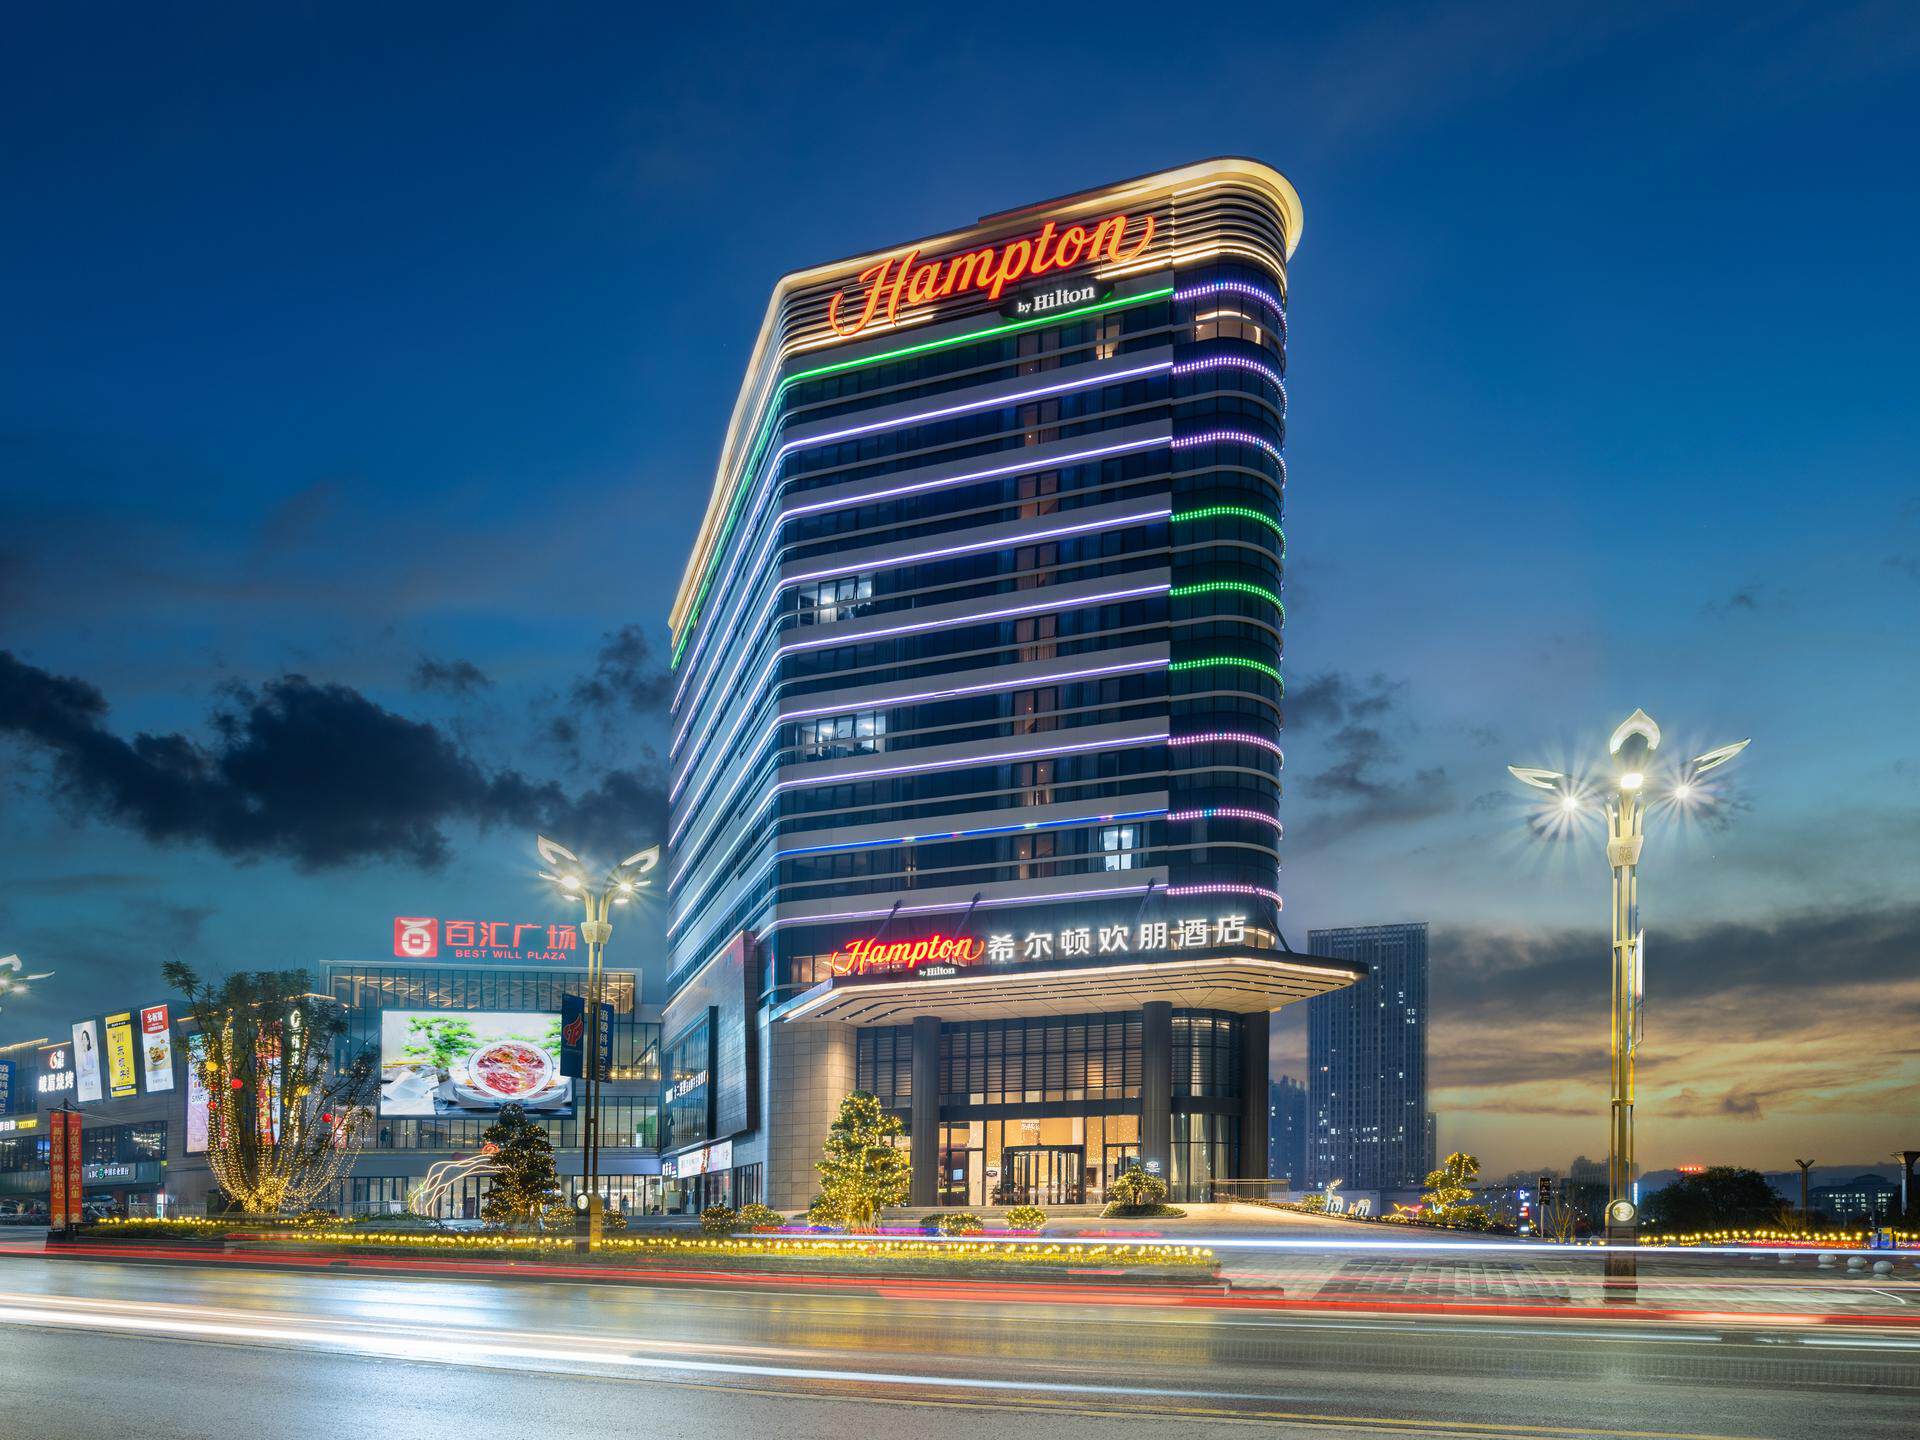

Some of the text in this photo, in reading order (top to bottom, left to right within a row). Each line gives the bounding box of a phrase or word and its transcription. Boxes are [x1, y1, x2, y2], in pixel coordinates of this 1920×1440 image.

[829, 214, 1155, 336] Hampton
[1017, 283, 1096, 314] by Hilton
[445, 920, 577, 951] 百汇广场
[988, 914, 1247, 963] 希尔顿欢朋酒店
[455, 949, 567, 961] BEST WILL PLAZA
[830, 933, 985, 975] Hampton
[919, 966, 956, 977] by Hilton
